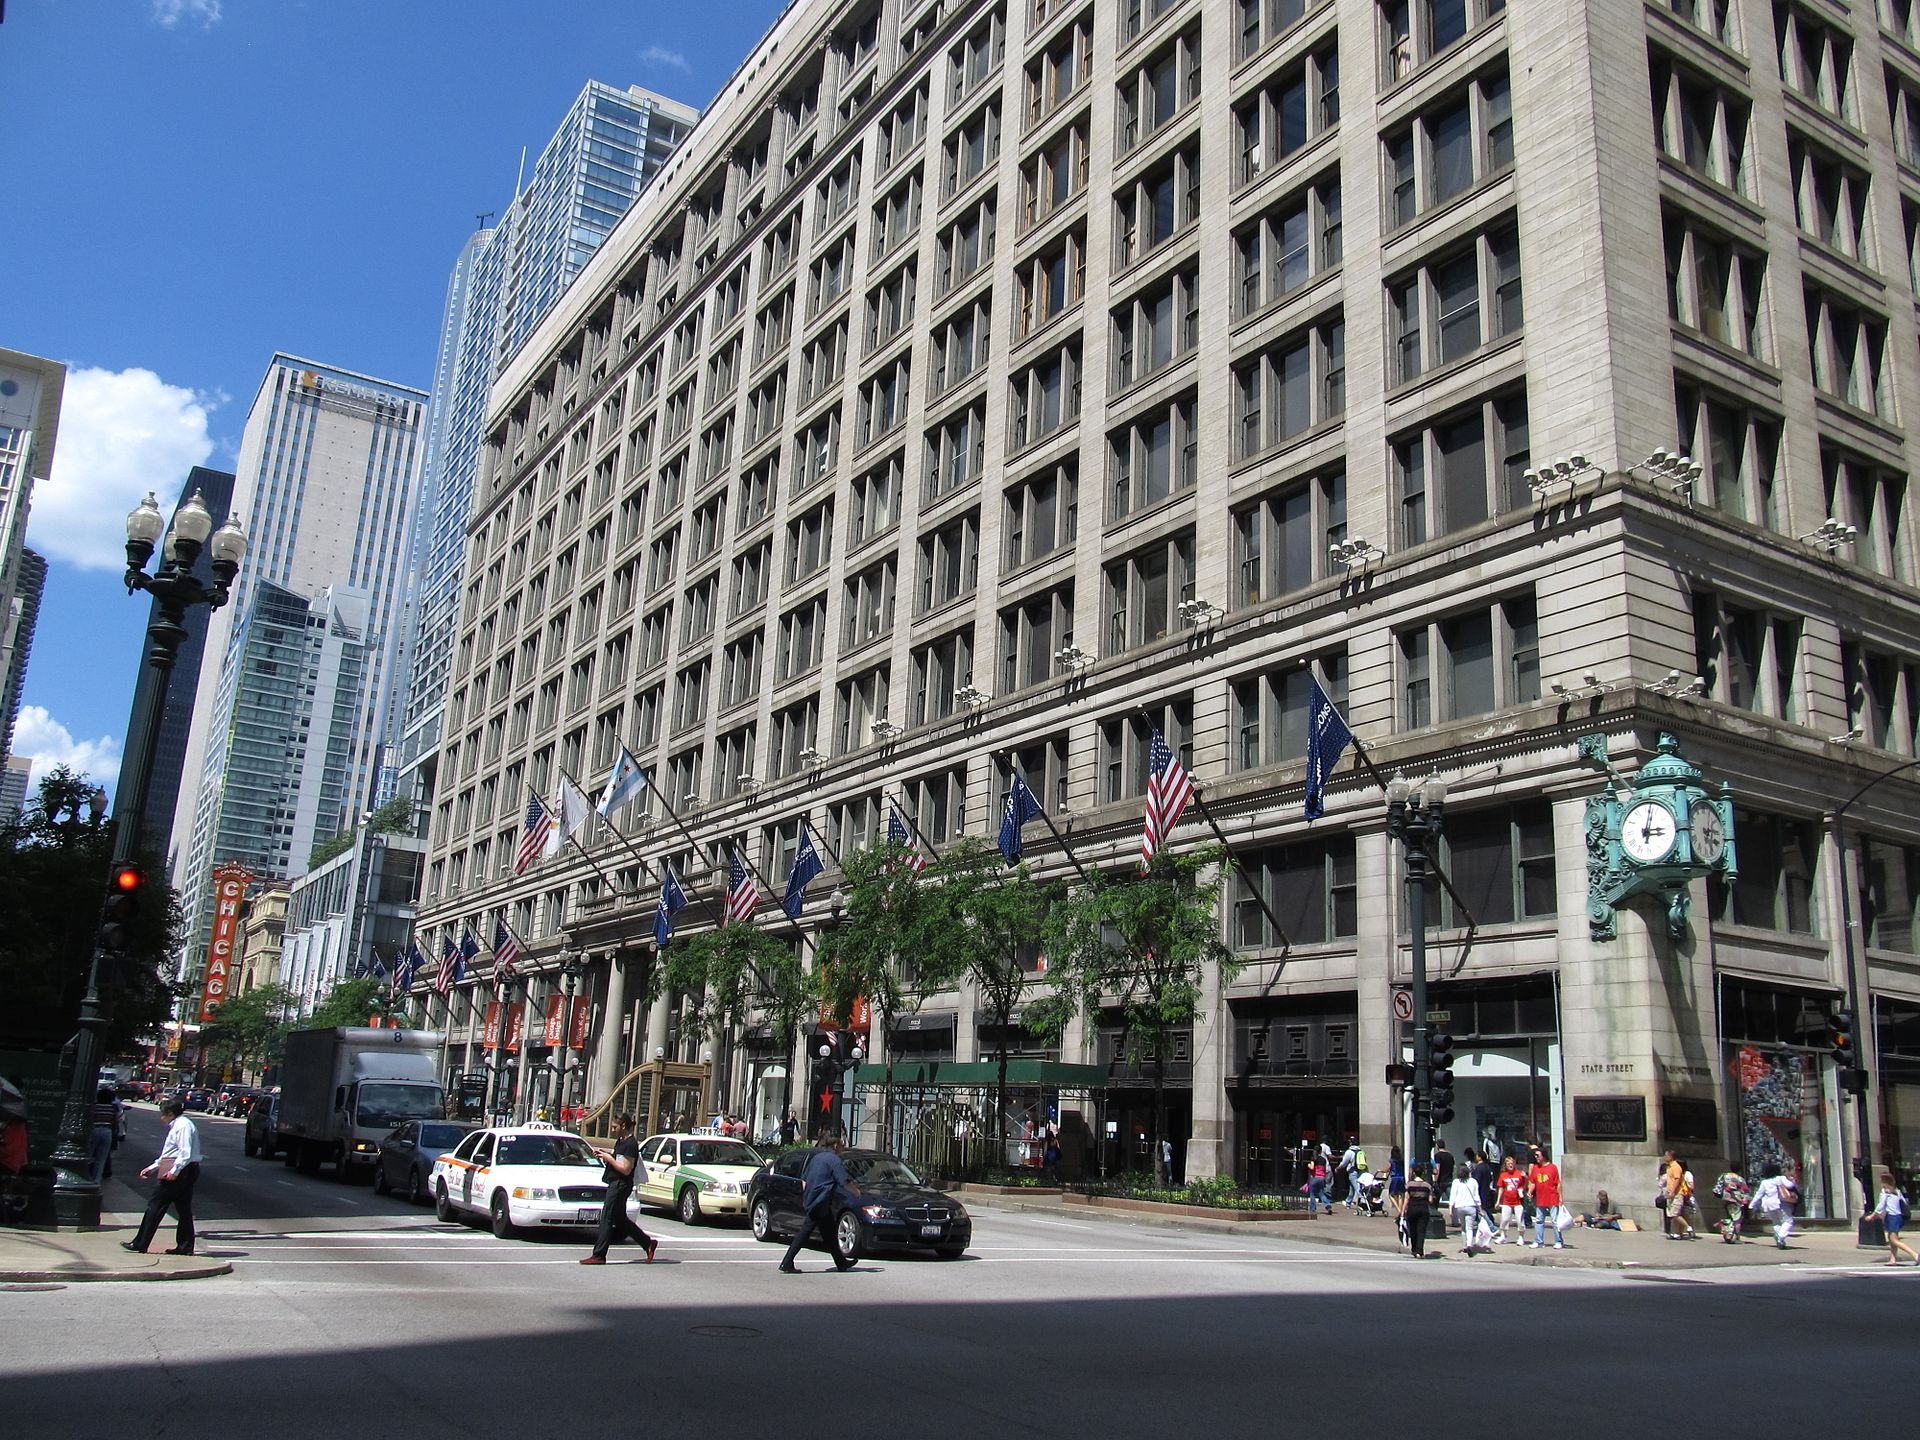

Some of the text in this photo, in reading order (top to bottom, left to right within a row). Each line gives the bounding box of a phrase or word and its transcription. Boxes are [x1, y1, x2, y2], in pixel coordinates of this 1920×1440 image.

[320, 377, 399, 408] KEMPER
[860, 1002, 868, 1024] Wor
[394, 1032, 402, 1043] 8
[1581, 1064, 1634, 1073] STATE STREET
[528, 1123, 553, 1131] TAXI
[1591, 1122, 1626, 1133] COMPANY
